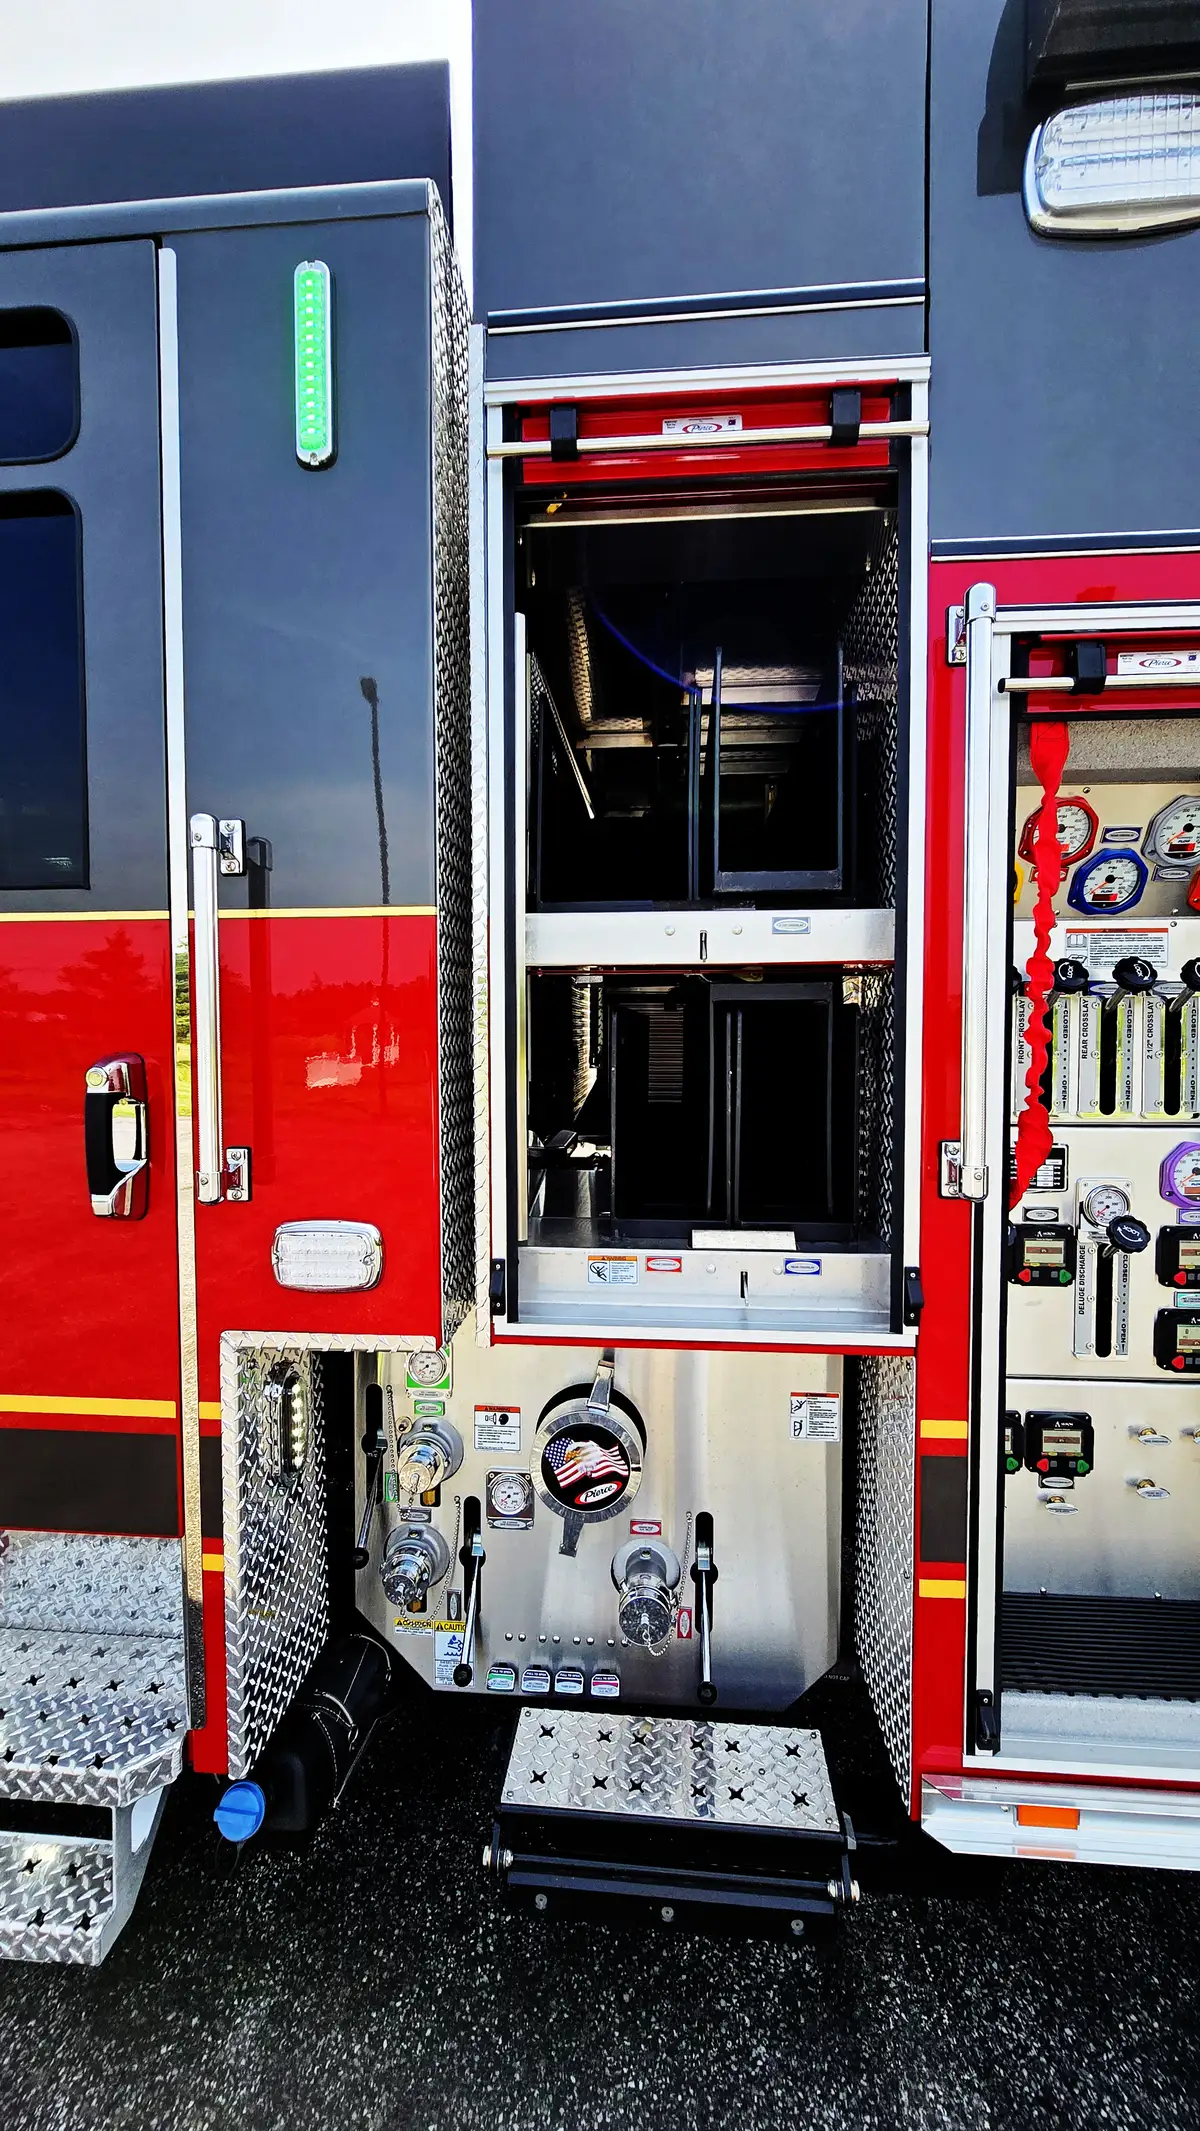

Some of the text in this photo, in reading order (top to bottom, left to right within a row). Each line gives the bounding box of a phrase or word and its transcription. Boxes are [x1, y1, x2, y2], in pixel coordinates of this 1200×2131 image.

[1148, 659, 1172, 668] Pierce
[1066, 965, 1074, 979] LOCK
[1133, 963, 1144, 977] LOCK
[1122, 1225, 1140, 1237] LOCK
[584, 1485, 615, 1502] Pierce
